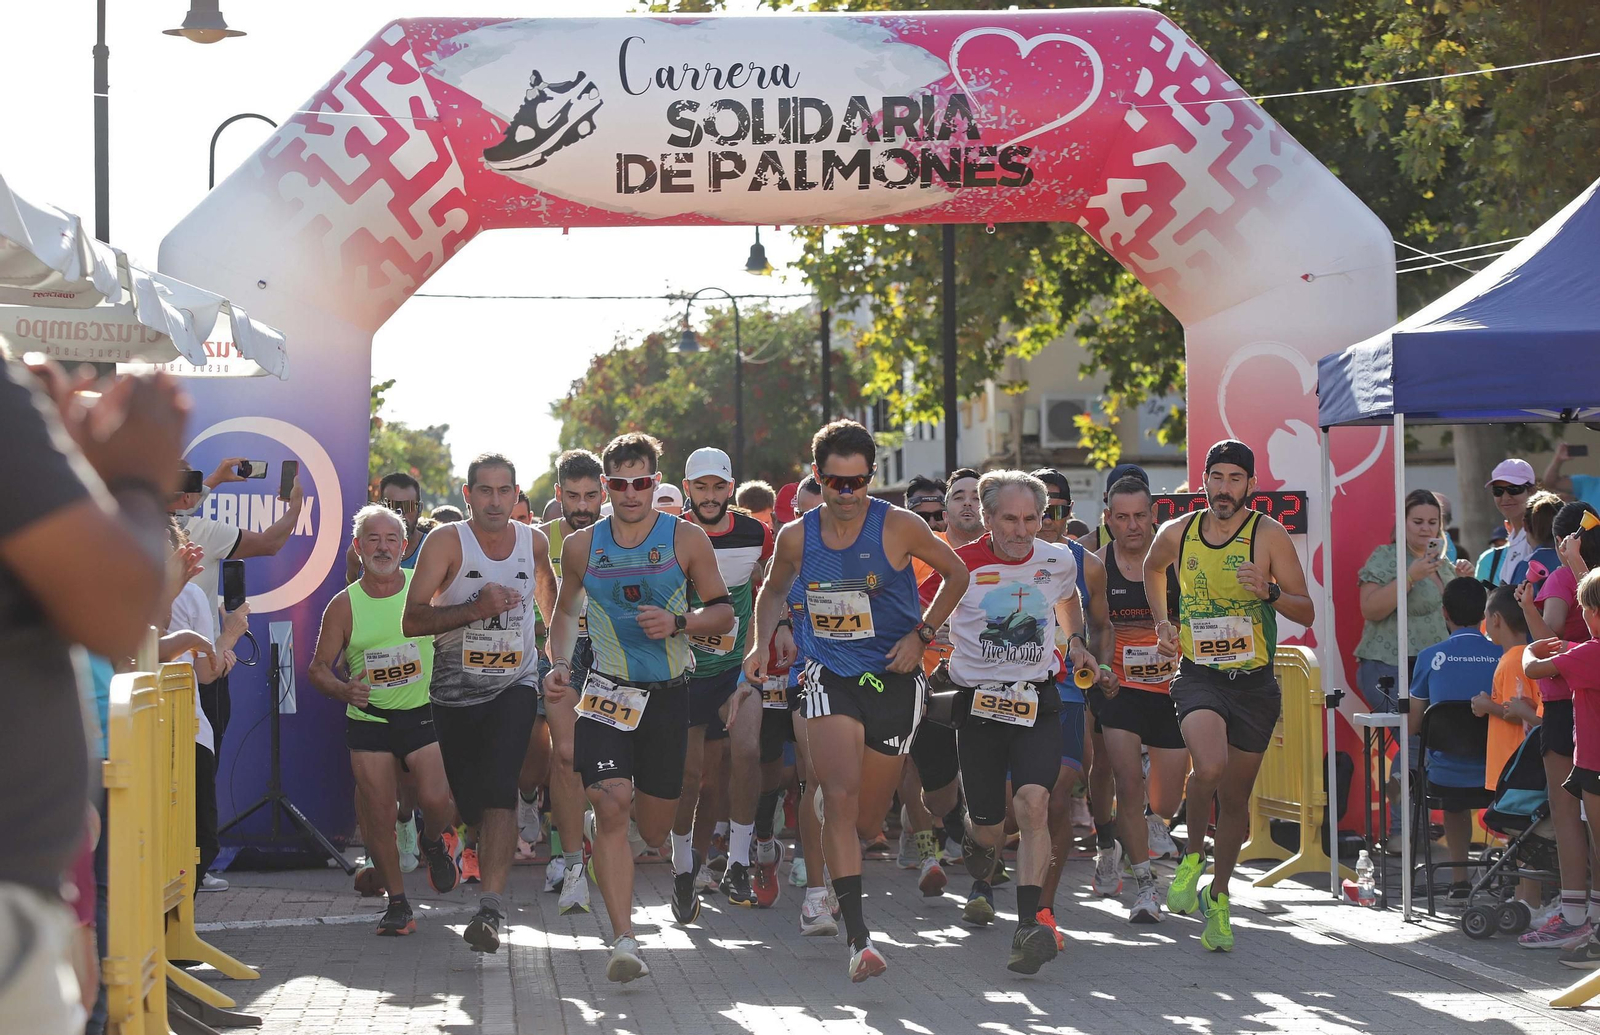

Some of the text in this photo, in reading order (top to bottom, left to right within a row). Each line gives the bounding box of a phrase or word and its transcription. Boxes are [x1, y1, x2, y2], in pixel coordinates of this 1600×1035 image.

[618, 36, 800, 97] Carrera
[666, 94, 982, 148] SOLIDARIA
[616, 145, 1035, 194] DE PALMONES
[815, 614, 862, 629] 271
[1200, 637, 1247, 654] 294
[469, 651, 517, 665] 274
[373, 662, 416, 681] 269
[1130, 661, 1173, 676] 254
[589, 696, 632, 721] 101
[980, 695, 1031, 715] 320
